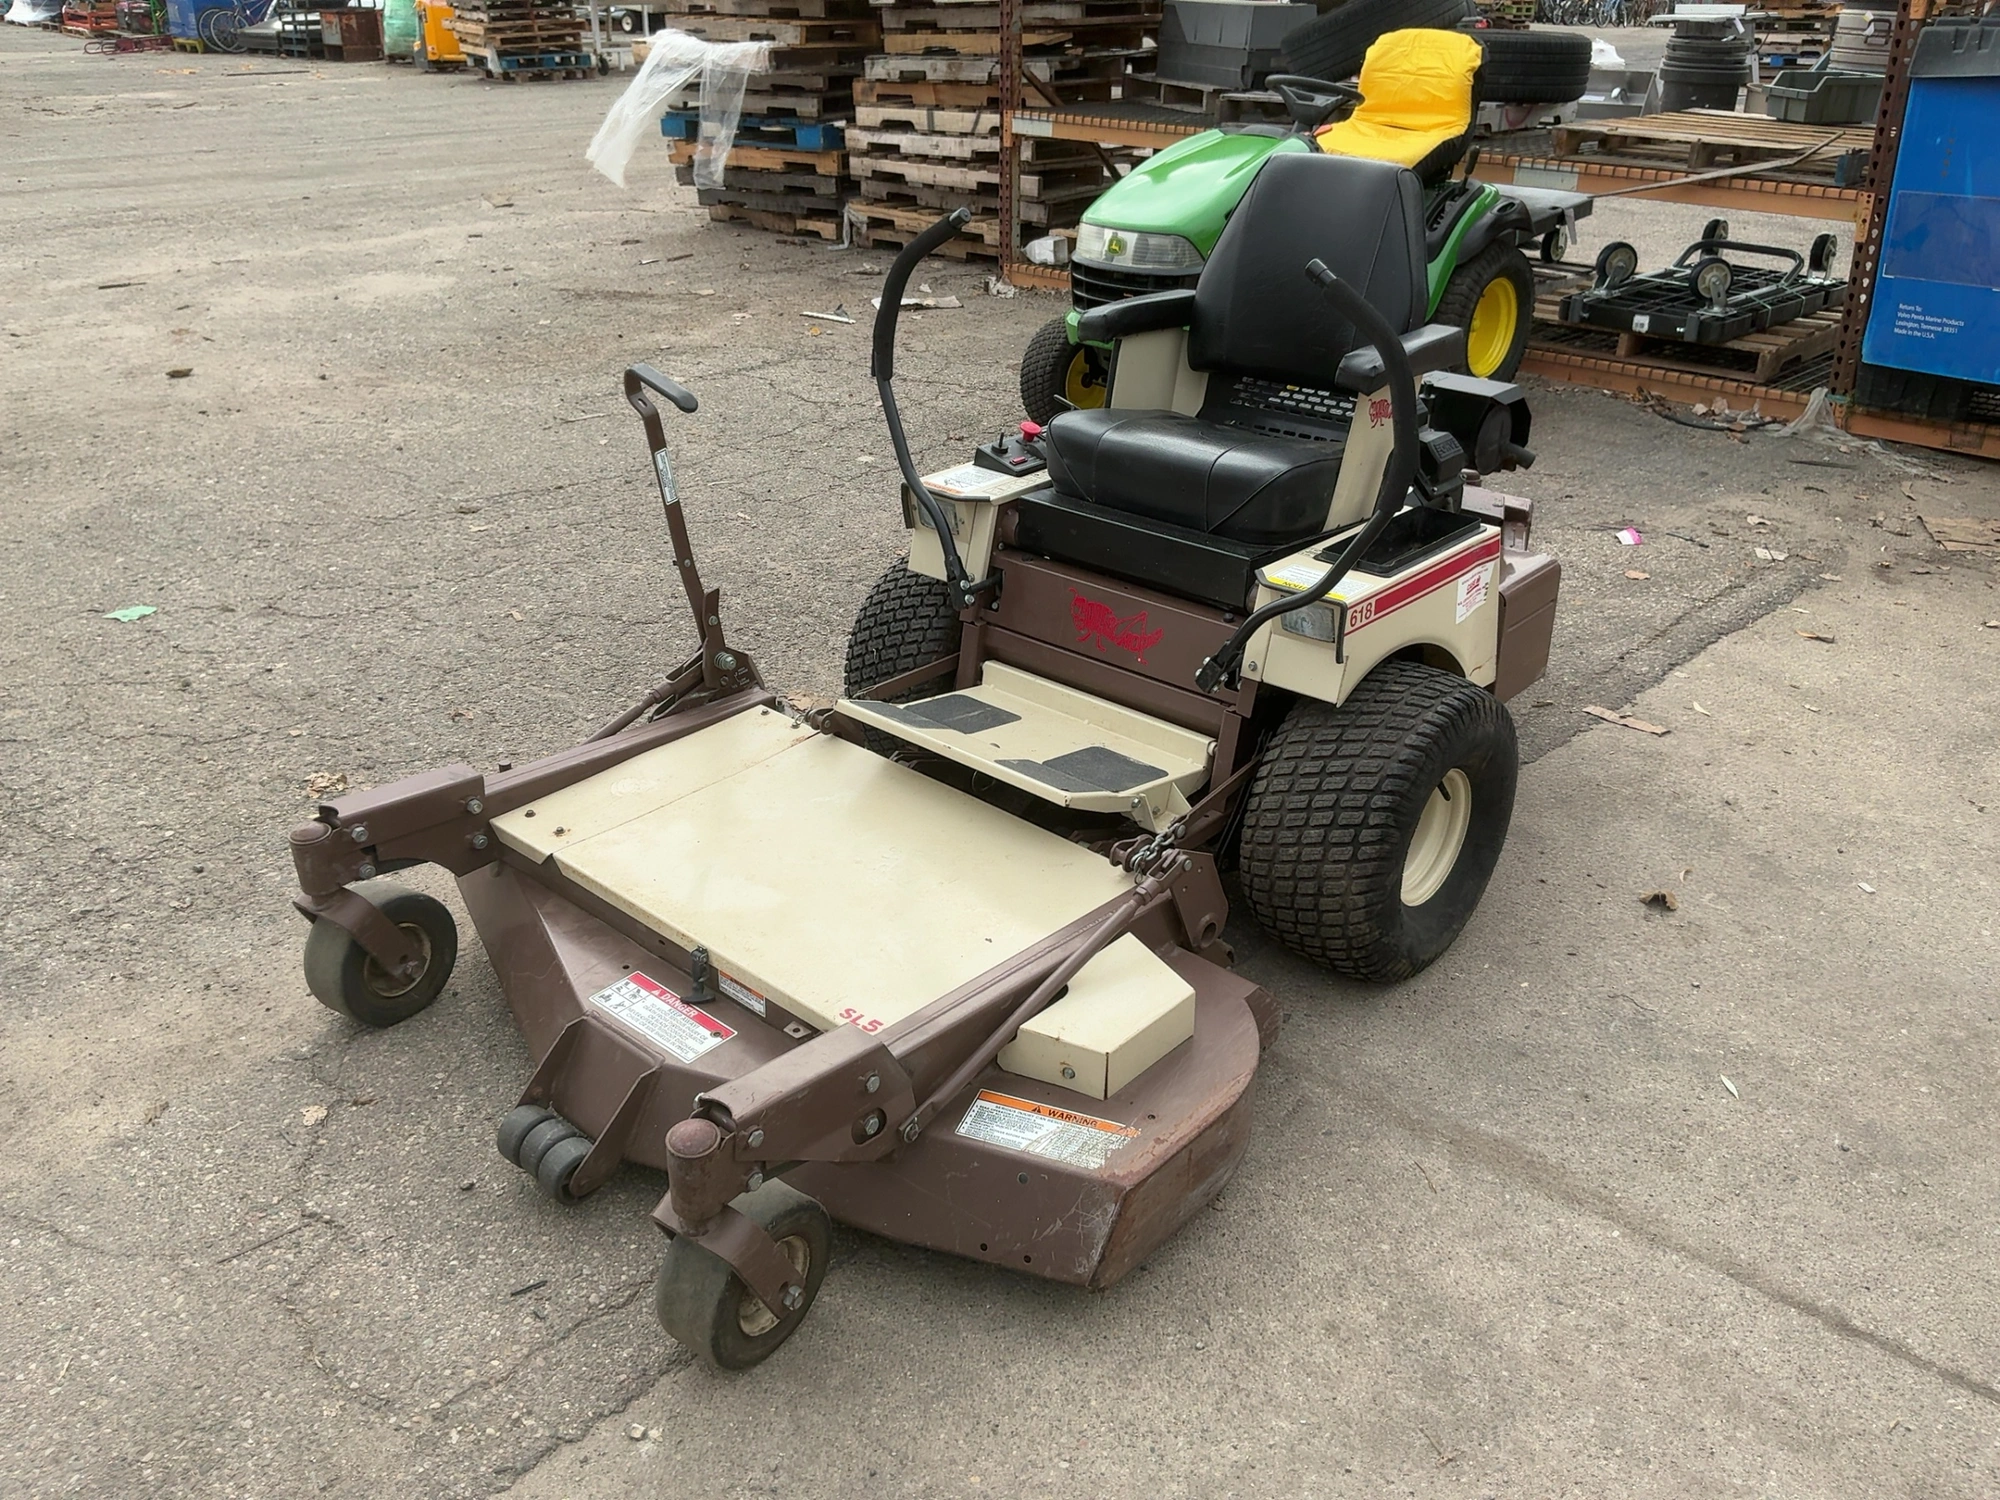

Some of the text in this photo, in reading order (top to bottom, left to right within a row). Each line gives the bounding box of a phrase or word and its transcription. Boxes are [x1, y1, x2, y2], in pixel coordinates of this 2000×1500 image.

[1899, 303, 1915, 311] Return
[1943, 318, 1964, 326] Products
[1349, 602, 1373, 627] 618
[659, 993, 698, 1016] DANGER
[1048, 1108, 1098, 1127] WARNING
